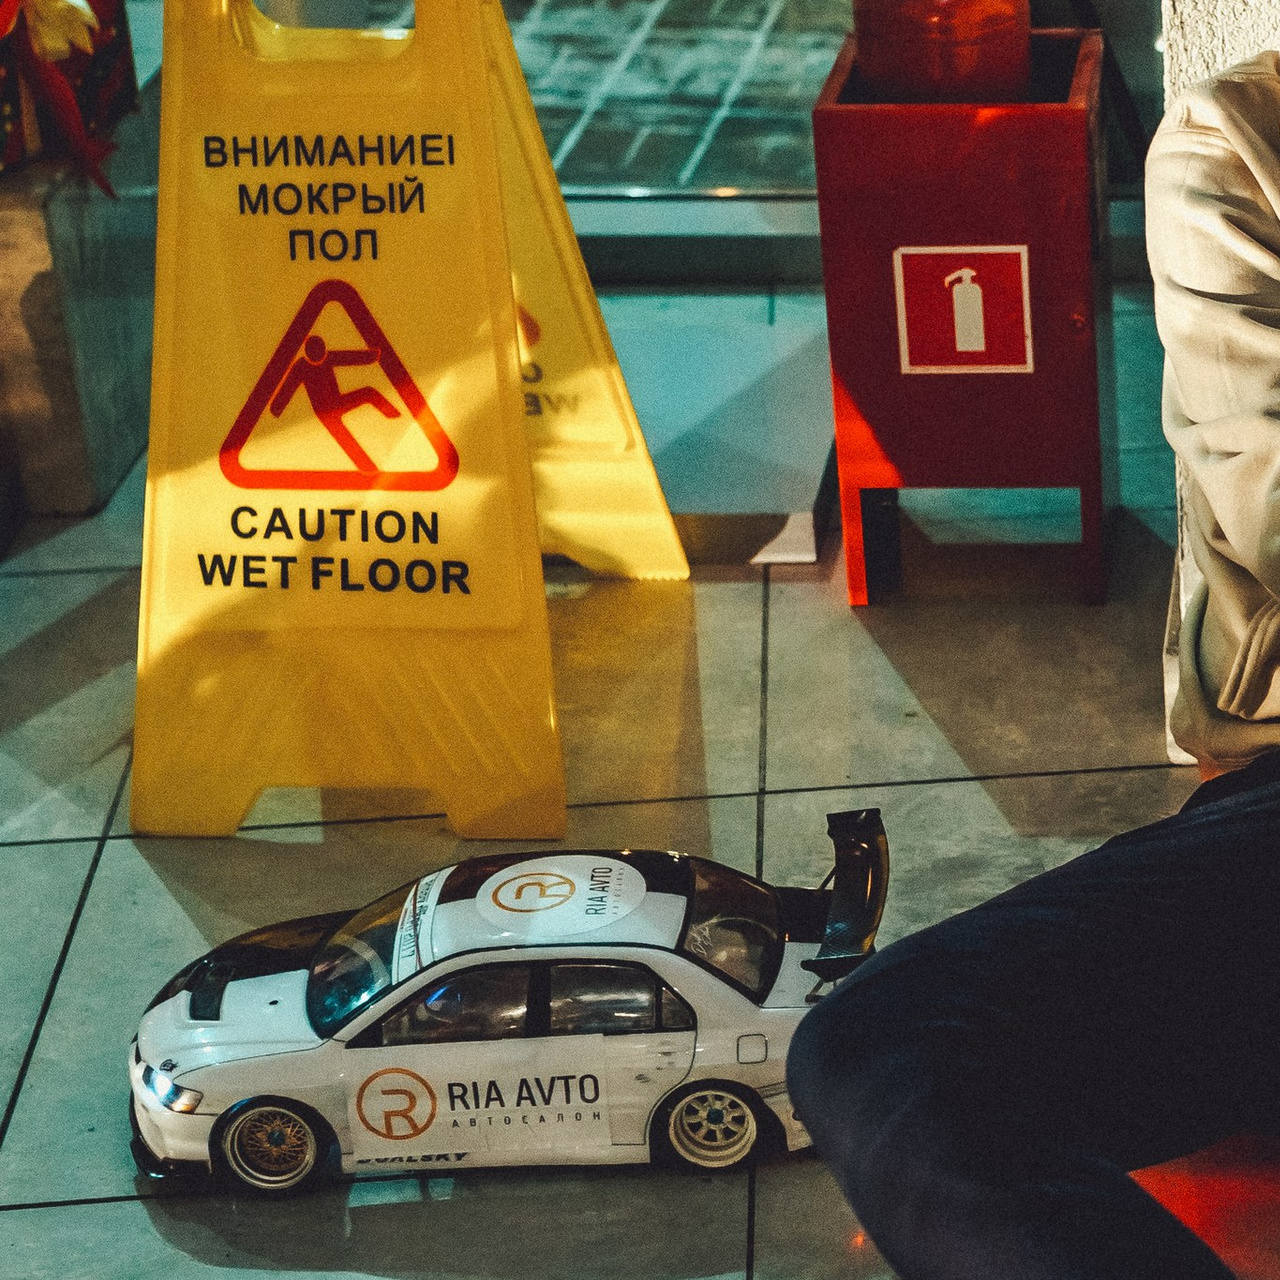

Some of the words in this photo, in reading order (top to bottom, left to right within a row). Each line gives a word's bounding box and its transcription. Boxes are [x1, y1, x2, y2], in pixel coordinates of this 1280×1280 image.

[238, 175, 425, 216] МОКРЫЙ
[288, 228, 379, 262] ПОЛ
[230, 505, 439, 545] CAUTION
[197, 552, 298, 590] WET
[310, 555, 472, 595] FLOOR
[588, 866, 613, 894] AVTO
[585, 895, 607, 916] RIA
[447, 1079, 506, 1111] RIA
[515, 1073, 601, 1108] AVTO
